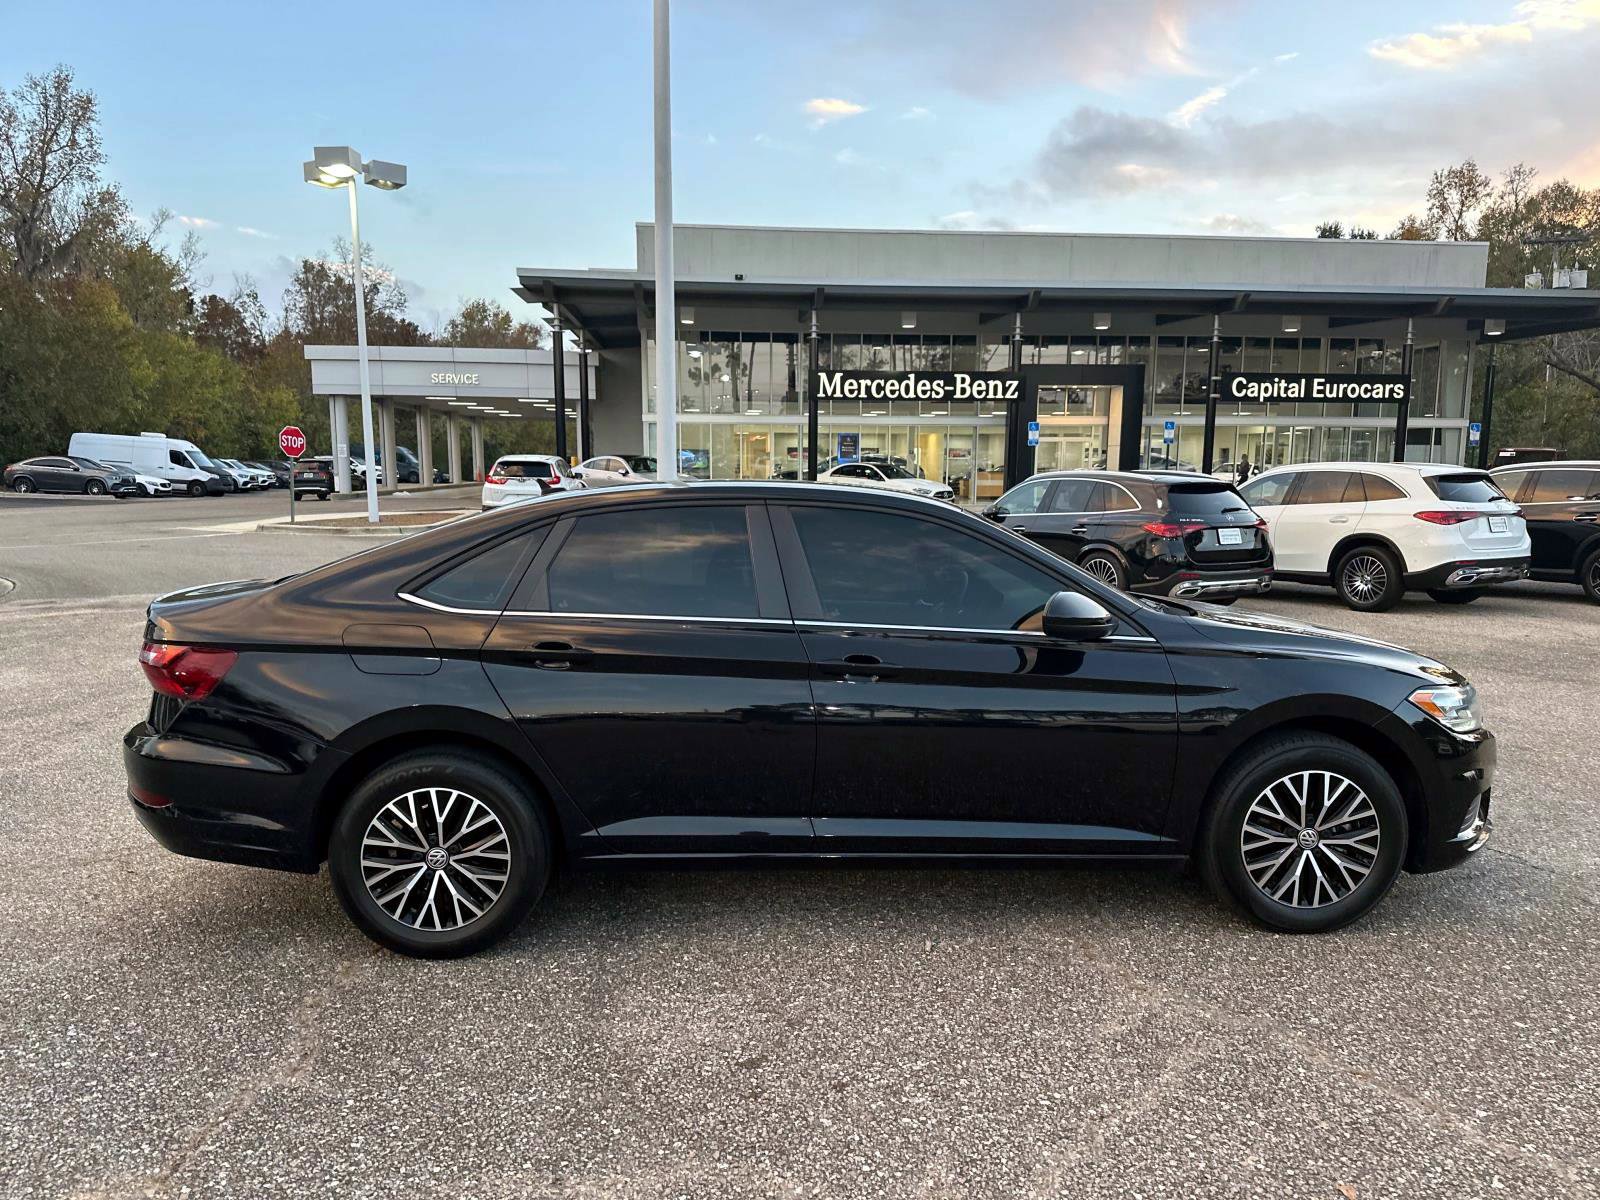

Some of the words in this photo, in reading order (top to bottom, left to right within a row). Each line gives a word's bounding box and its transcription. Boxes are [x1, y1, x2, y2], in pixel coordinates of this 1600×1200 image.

[430, 372, 480, 385] SERVICE
[816, 371, 1020, 400] Mercedes-Benz
[1231, 376, 1306, 402] Capital
[1312, 378, 1405, 400] Eurocars
[281, 434, 304, 449] STOP
